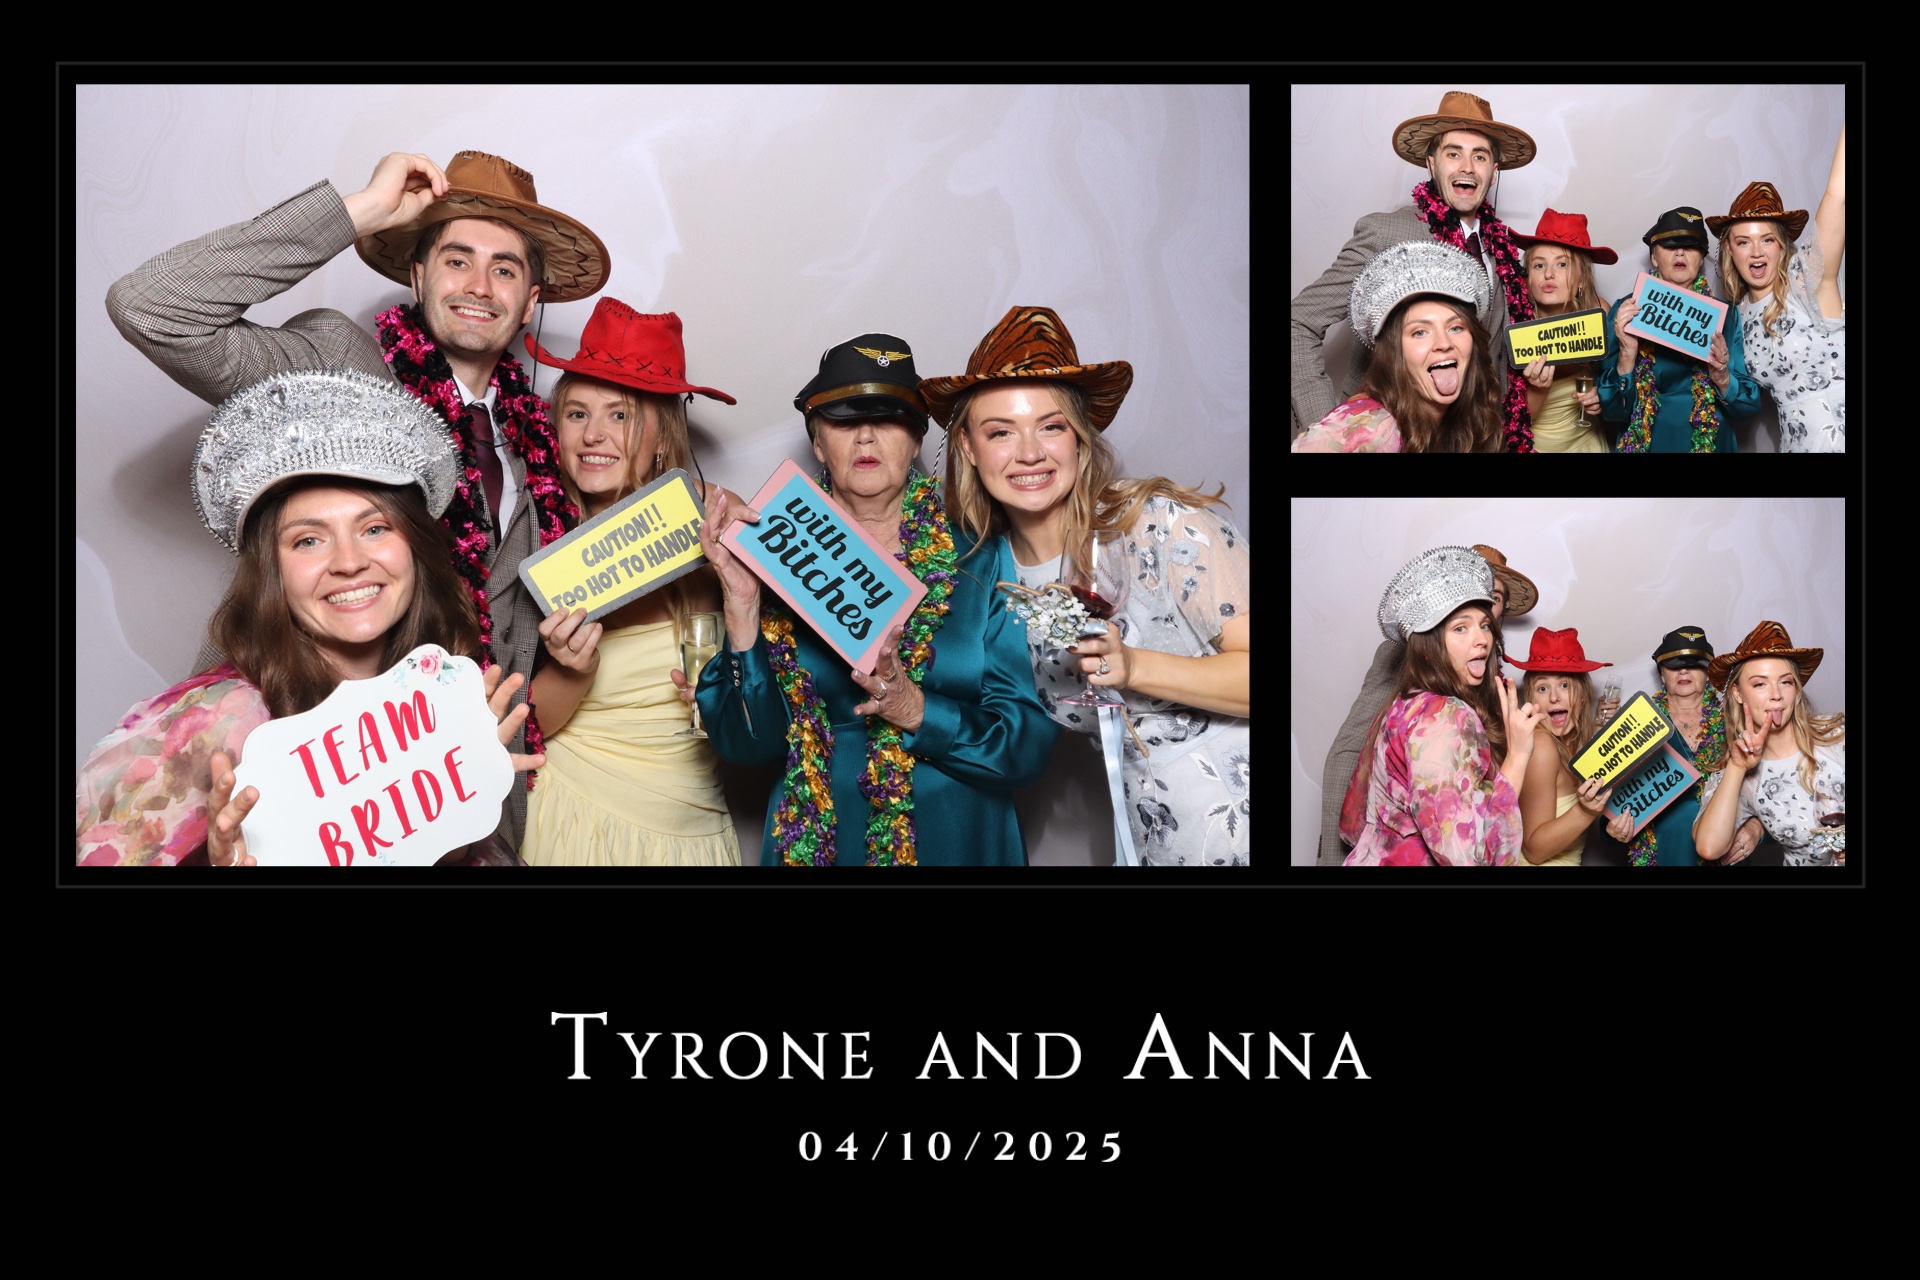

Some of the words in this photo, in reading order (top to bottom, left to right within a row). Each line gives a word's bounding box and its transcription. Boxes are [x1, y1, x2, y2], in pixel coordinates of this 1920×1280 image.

[1538, 321, 1586, 341] CAUTION!!
[1640, 303, 1709, 347] Bitches
[1647, 289, 1684, 313] with
[1685, 306, 1713, 329] my
[1515, 347, 1534, 358] TOO
[1535, 344, 1553, 357] HOT
[1555, 342, 1567, 354] TO
[1568, 336, 1603, 353] HANDLE
[581, 503, 667, 567] CAUTION!!
[785, 497, 847, 561] with
[843, 558, 894, 609] my
[551, 585, 588, 609] TOO
[585, 564, 621, 597] HOT
[618, 554, 645, 578] TO
[757, 515, 873, 640] Bitches
[289, 690, 436, 798] TEAM
[1598, 713, 1641, 757] CAUTION!!
[1604, 752, 1623, 772] HOT
[1619, 744, 1634, 758] TO
[1629, 716, 1666, 750] HANDLE
[318, 745, 477, 866] BRIDE
[1612, 778, 1645, 807] with
[1644, 757, 1670, 781] my
